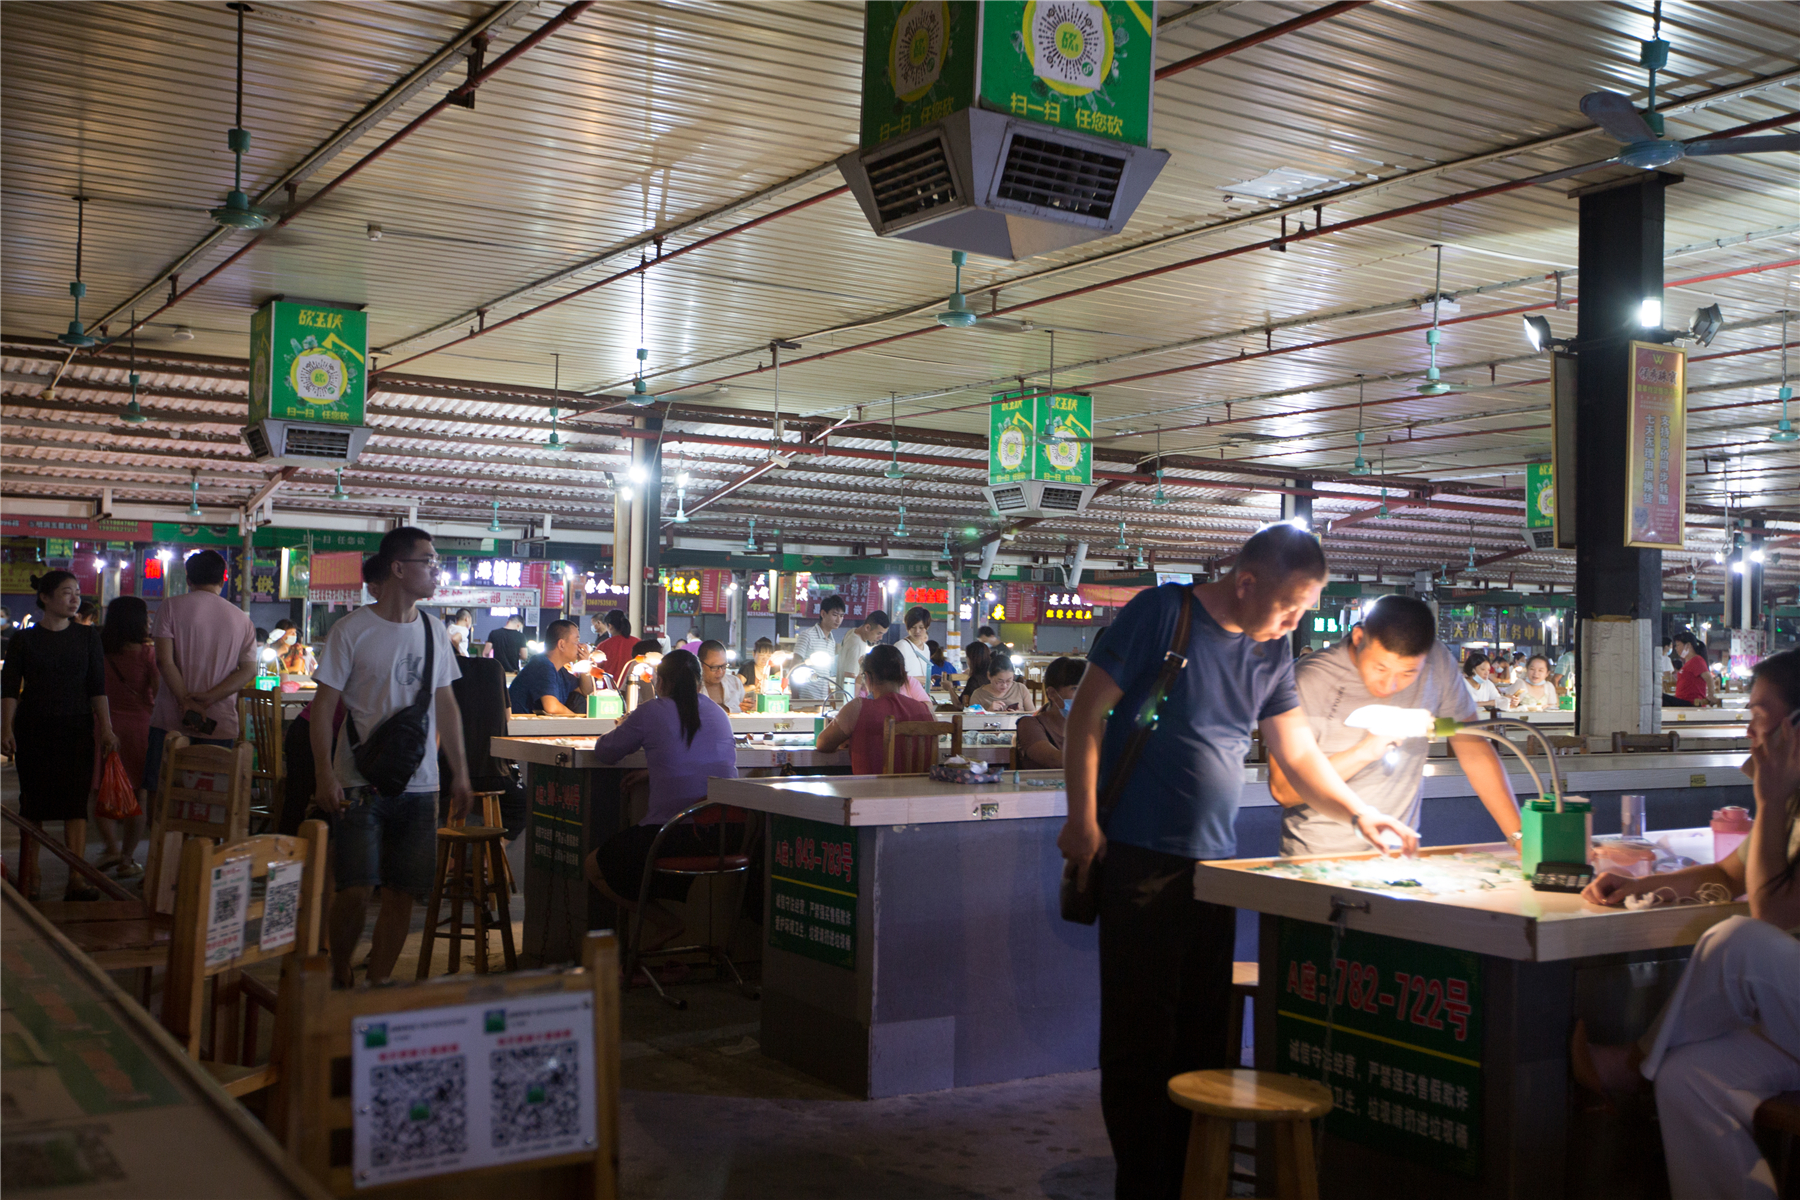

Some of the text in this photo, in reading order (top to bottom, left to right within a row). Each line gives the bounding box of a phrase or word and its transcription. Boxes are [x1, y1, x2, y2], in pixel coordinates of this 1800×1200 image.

[880, 96, 955, 142] 扫一扫 任您砍
[1010, 92, 1124, 138] 扫一扫 任您砍
[286, 406, 350, 423] 扫一扫 任您砍
[1643, 413, 1656, 505] 七天无理由退换货
[337, 535, 367, 547] 任您砍
